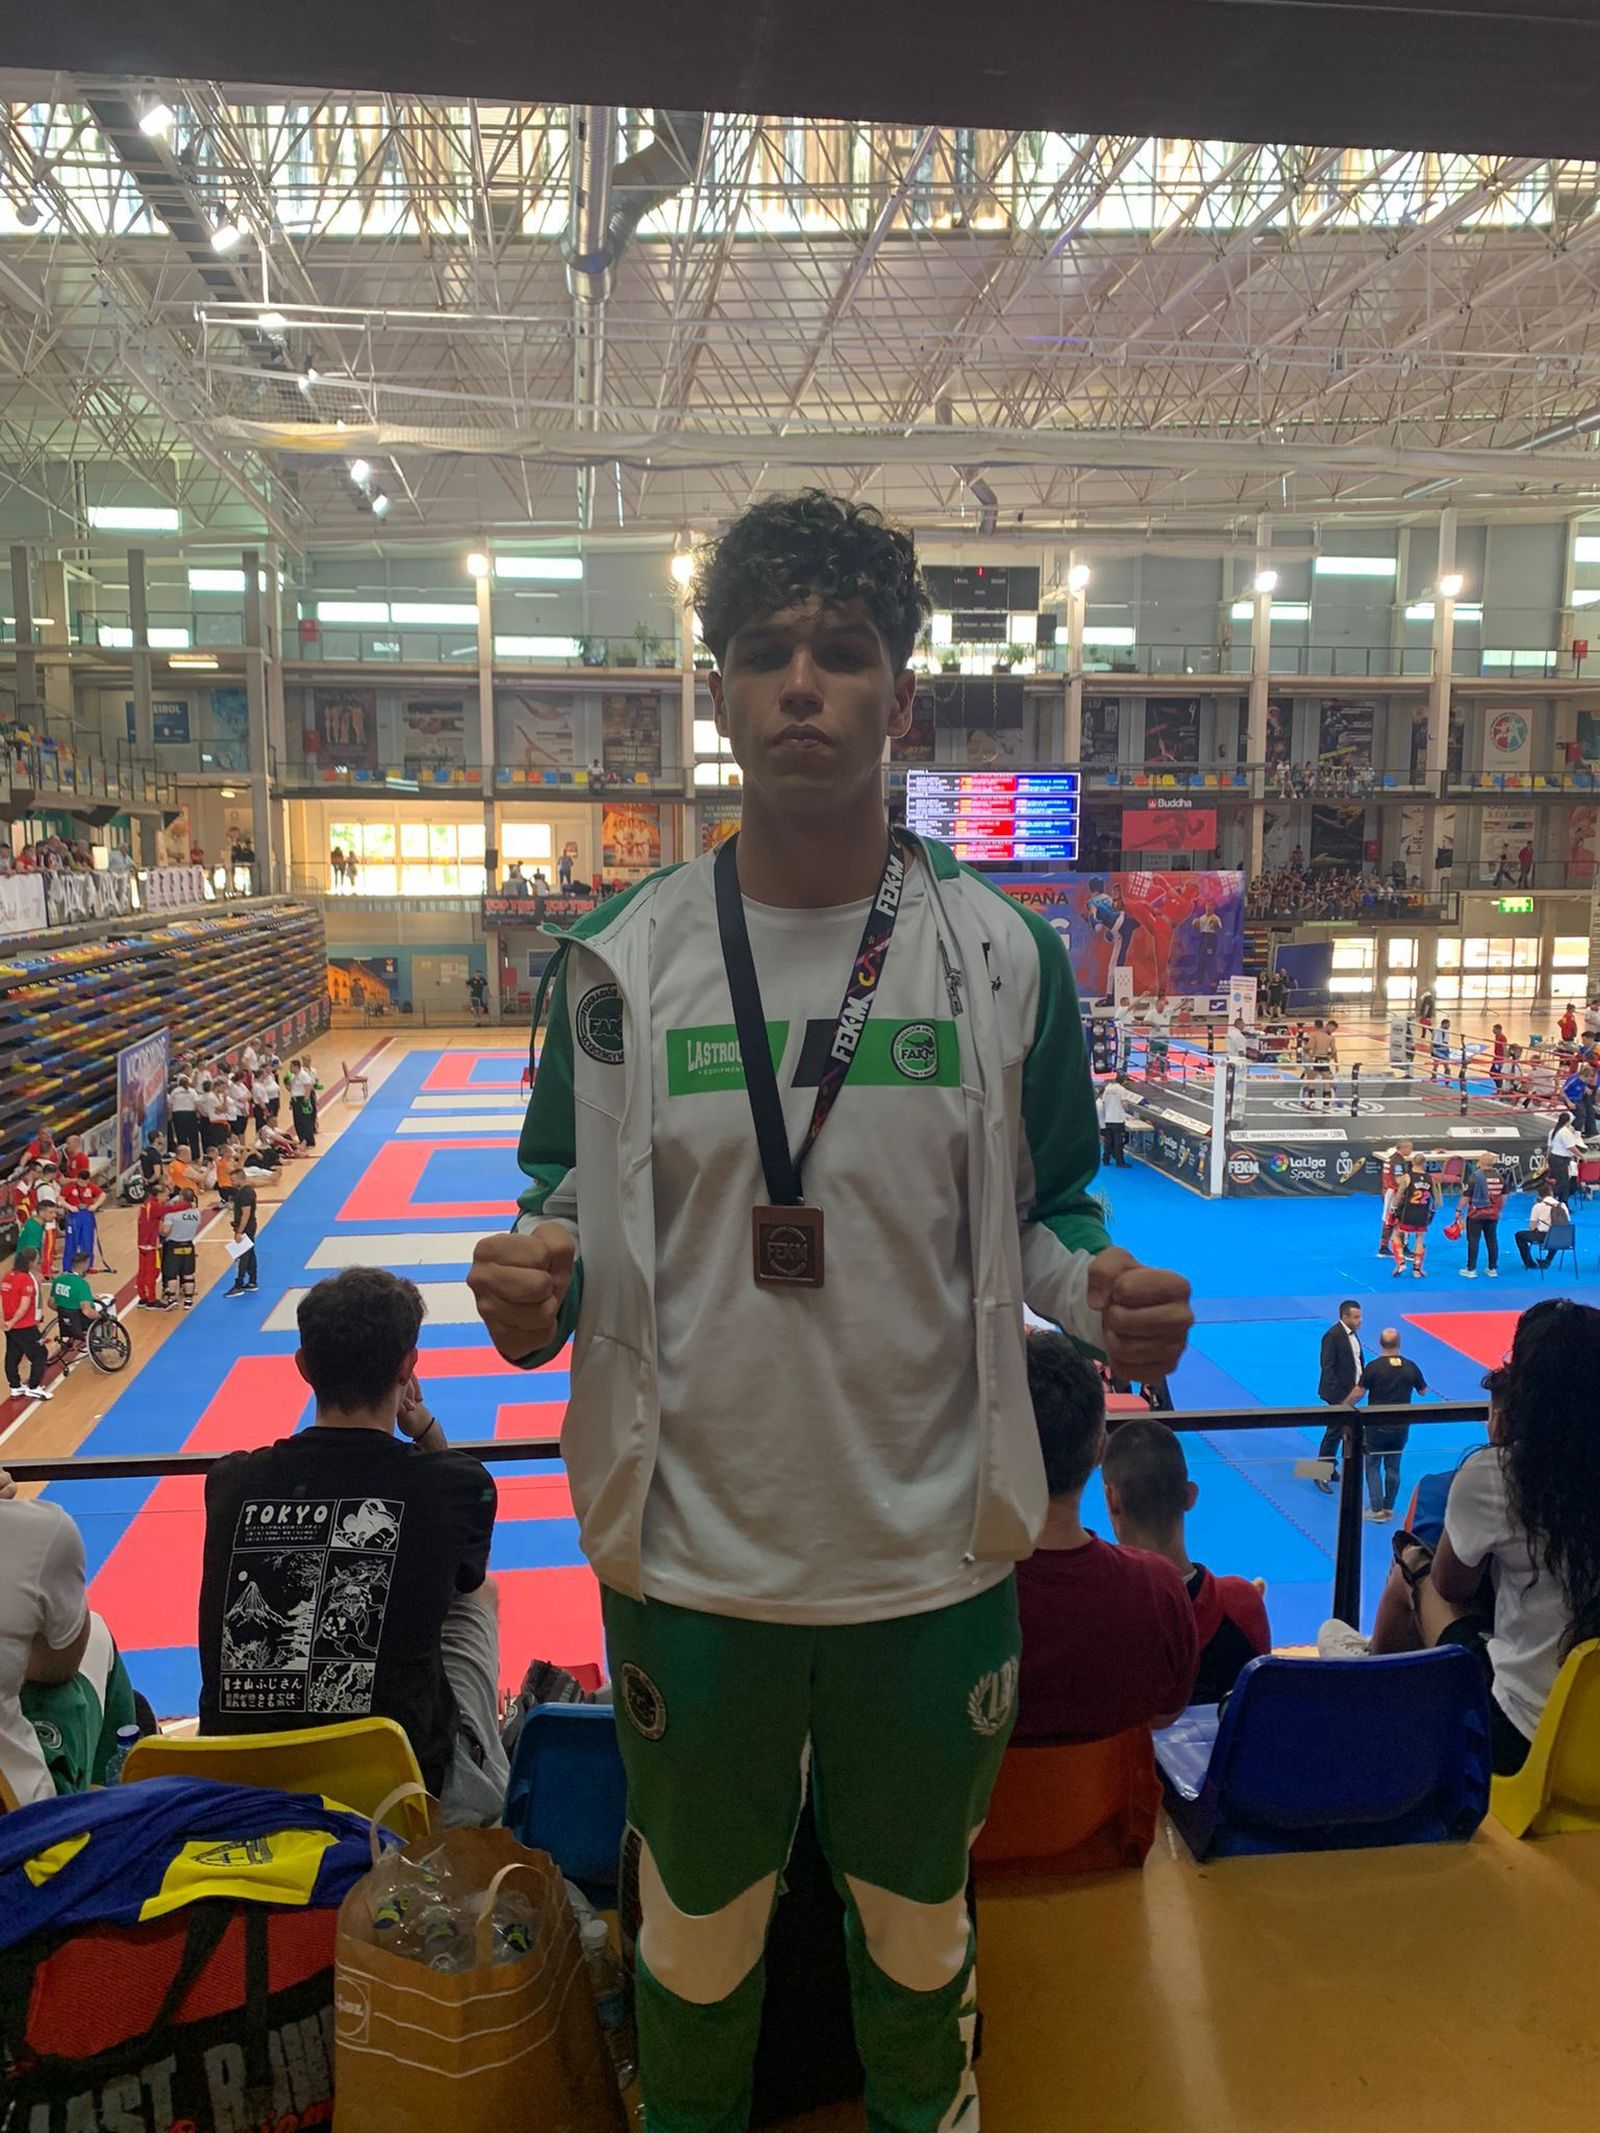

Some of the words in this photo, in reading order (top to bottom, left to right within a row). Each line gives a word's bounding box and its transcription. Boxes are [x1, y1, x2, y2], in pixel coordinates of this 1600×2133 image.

[1158, 798, 1192, 808] Buddha
[874, 854, 905, 917] FEKM
[1008, 888, 1069, 904] SPAÑA
[831, 990, 876, 1064] FEKM
[1228, 1161, 1260, 1174] FEKM
[1290, 1157, 1326, 1169] LaLiga
[1290, 1168, 1326, 1180] Sports
[1410, 1190, 1431, 1204] 22
[182, 1213, 199, 1222] CAN
[245, 1505, 328, 1525] TOKYO
